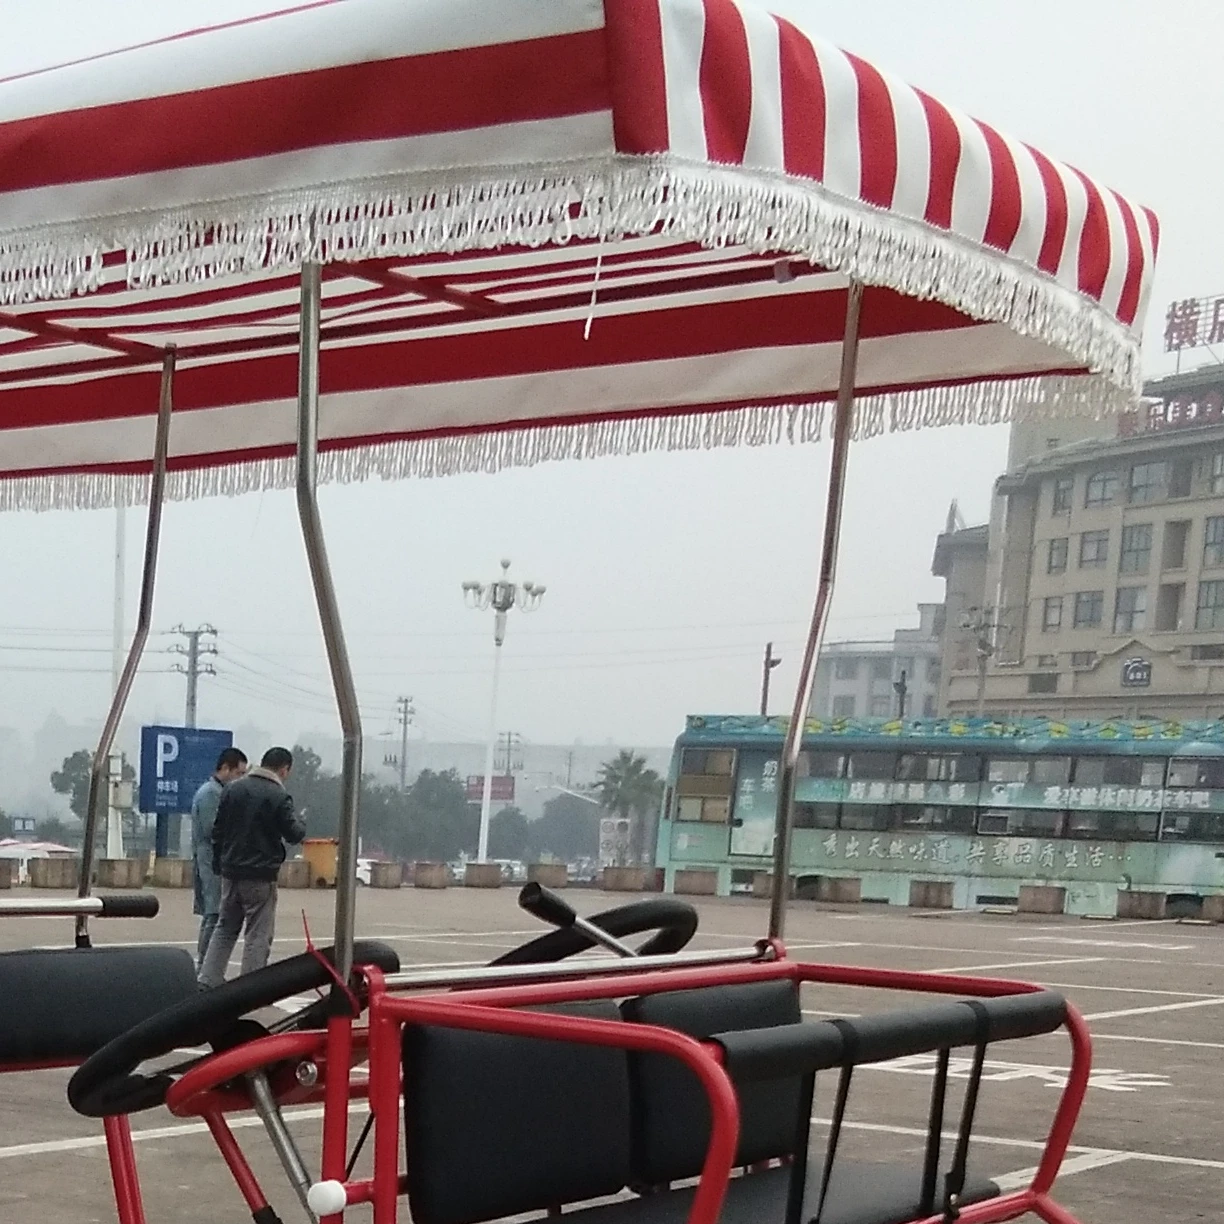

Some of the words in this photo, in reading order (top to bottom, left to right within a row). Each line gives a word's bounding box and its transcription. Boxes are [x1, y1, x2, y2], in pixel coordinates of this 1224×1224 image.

[156, 734, 179, 778] P
[761, 760, 779, 793] 奶茶
[739, 778, 756, 810] 车吧
